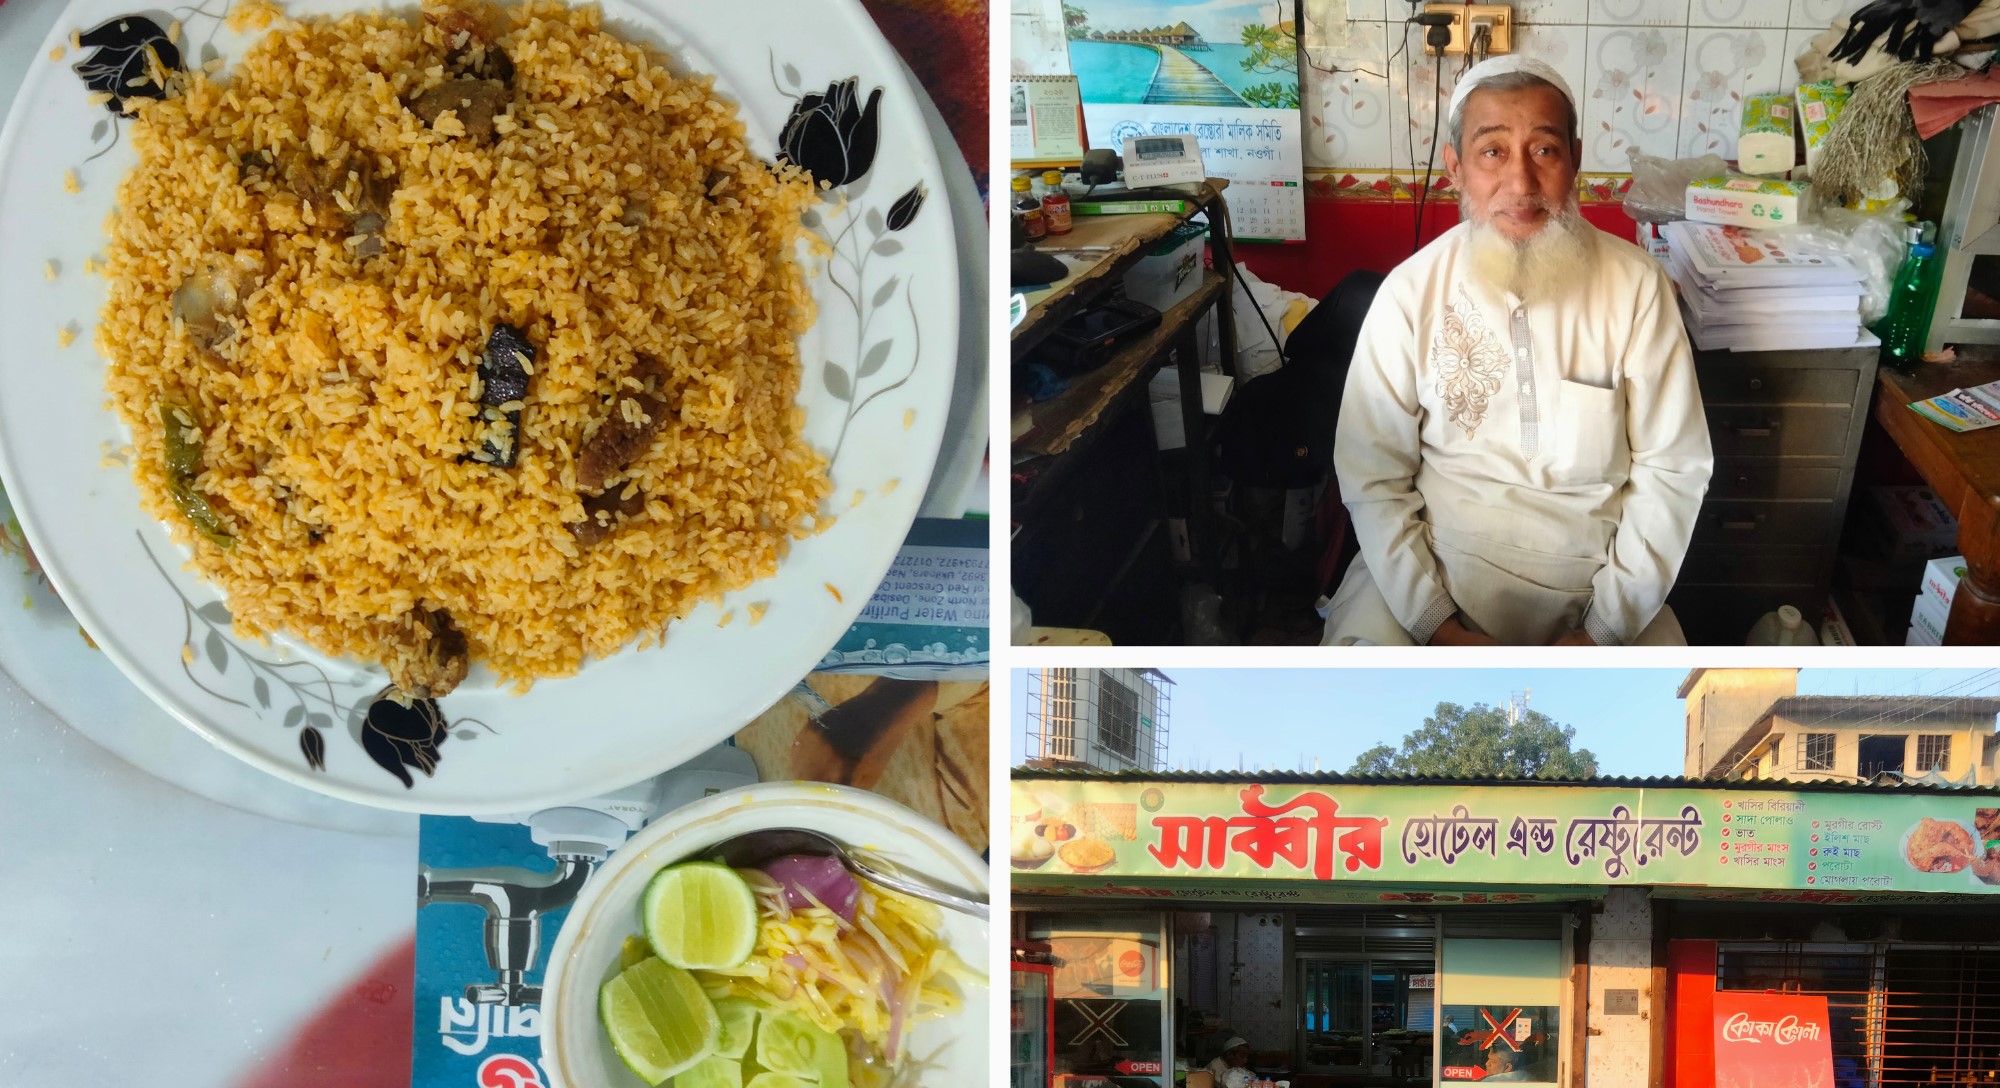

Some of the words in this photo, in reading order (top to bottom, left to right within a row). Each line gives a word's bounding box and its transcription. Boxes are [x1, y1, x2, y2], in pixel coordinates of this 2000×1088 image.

[1227, 118, 1253, 141] মালিক
[1255, 118, 1282, 142] সমিতি
[1693, 195, 1743, 209] Bashundhara
[895, 582, 944, 593] Crescent
[948, 585, 969, 594] Red
[915, 607, 957, 621] Water
[1737, 799, 1764, 811] খাসির
[1767, 799, 1806, 812] বিরিয়ানী
[1736, 815, 1757, 825] সাদা
[1760, 815, 1794, 826] পোলাও
[1148, 784, 1388, 881] সাব্বীর
[1402, 805, 1499, 865] হোটেল
[1506, 816, 1557, 857] এন্ড
[1565, 806, 1703, 878] রেষ্টুরেন্ট
[1735, 828, 1756, 839] ভাত
[1824, 831, 1850, 844] ইলিশ
[1853, 834, 1871, 845] মাছ
[1733, 840, 1763, 854] মুরগীর
[1766, 843, 1790, 854] মাংস
[1822, 845, 1840, 857] রুই
[1843, 848, 1861, 859] মাছ
[1733, 854, 1760, 867] খাসির
[1763, 857, 1786, 867] মাংস
[1822, 860, 1853, 872] পরোটা
[1861, 876, 1894, 887] পরোটা
[1722, 1012, 1777, 1044] কোকা
[1130, 1063, 1160, 1072] OPEN
[1443, 1068, 1473, 1078] OPEN
